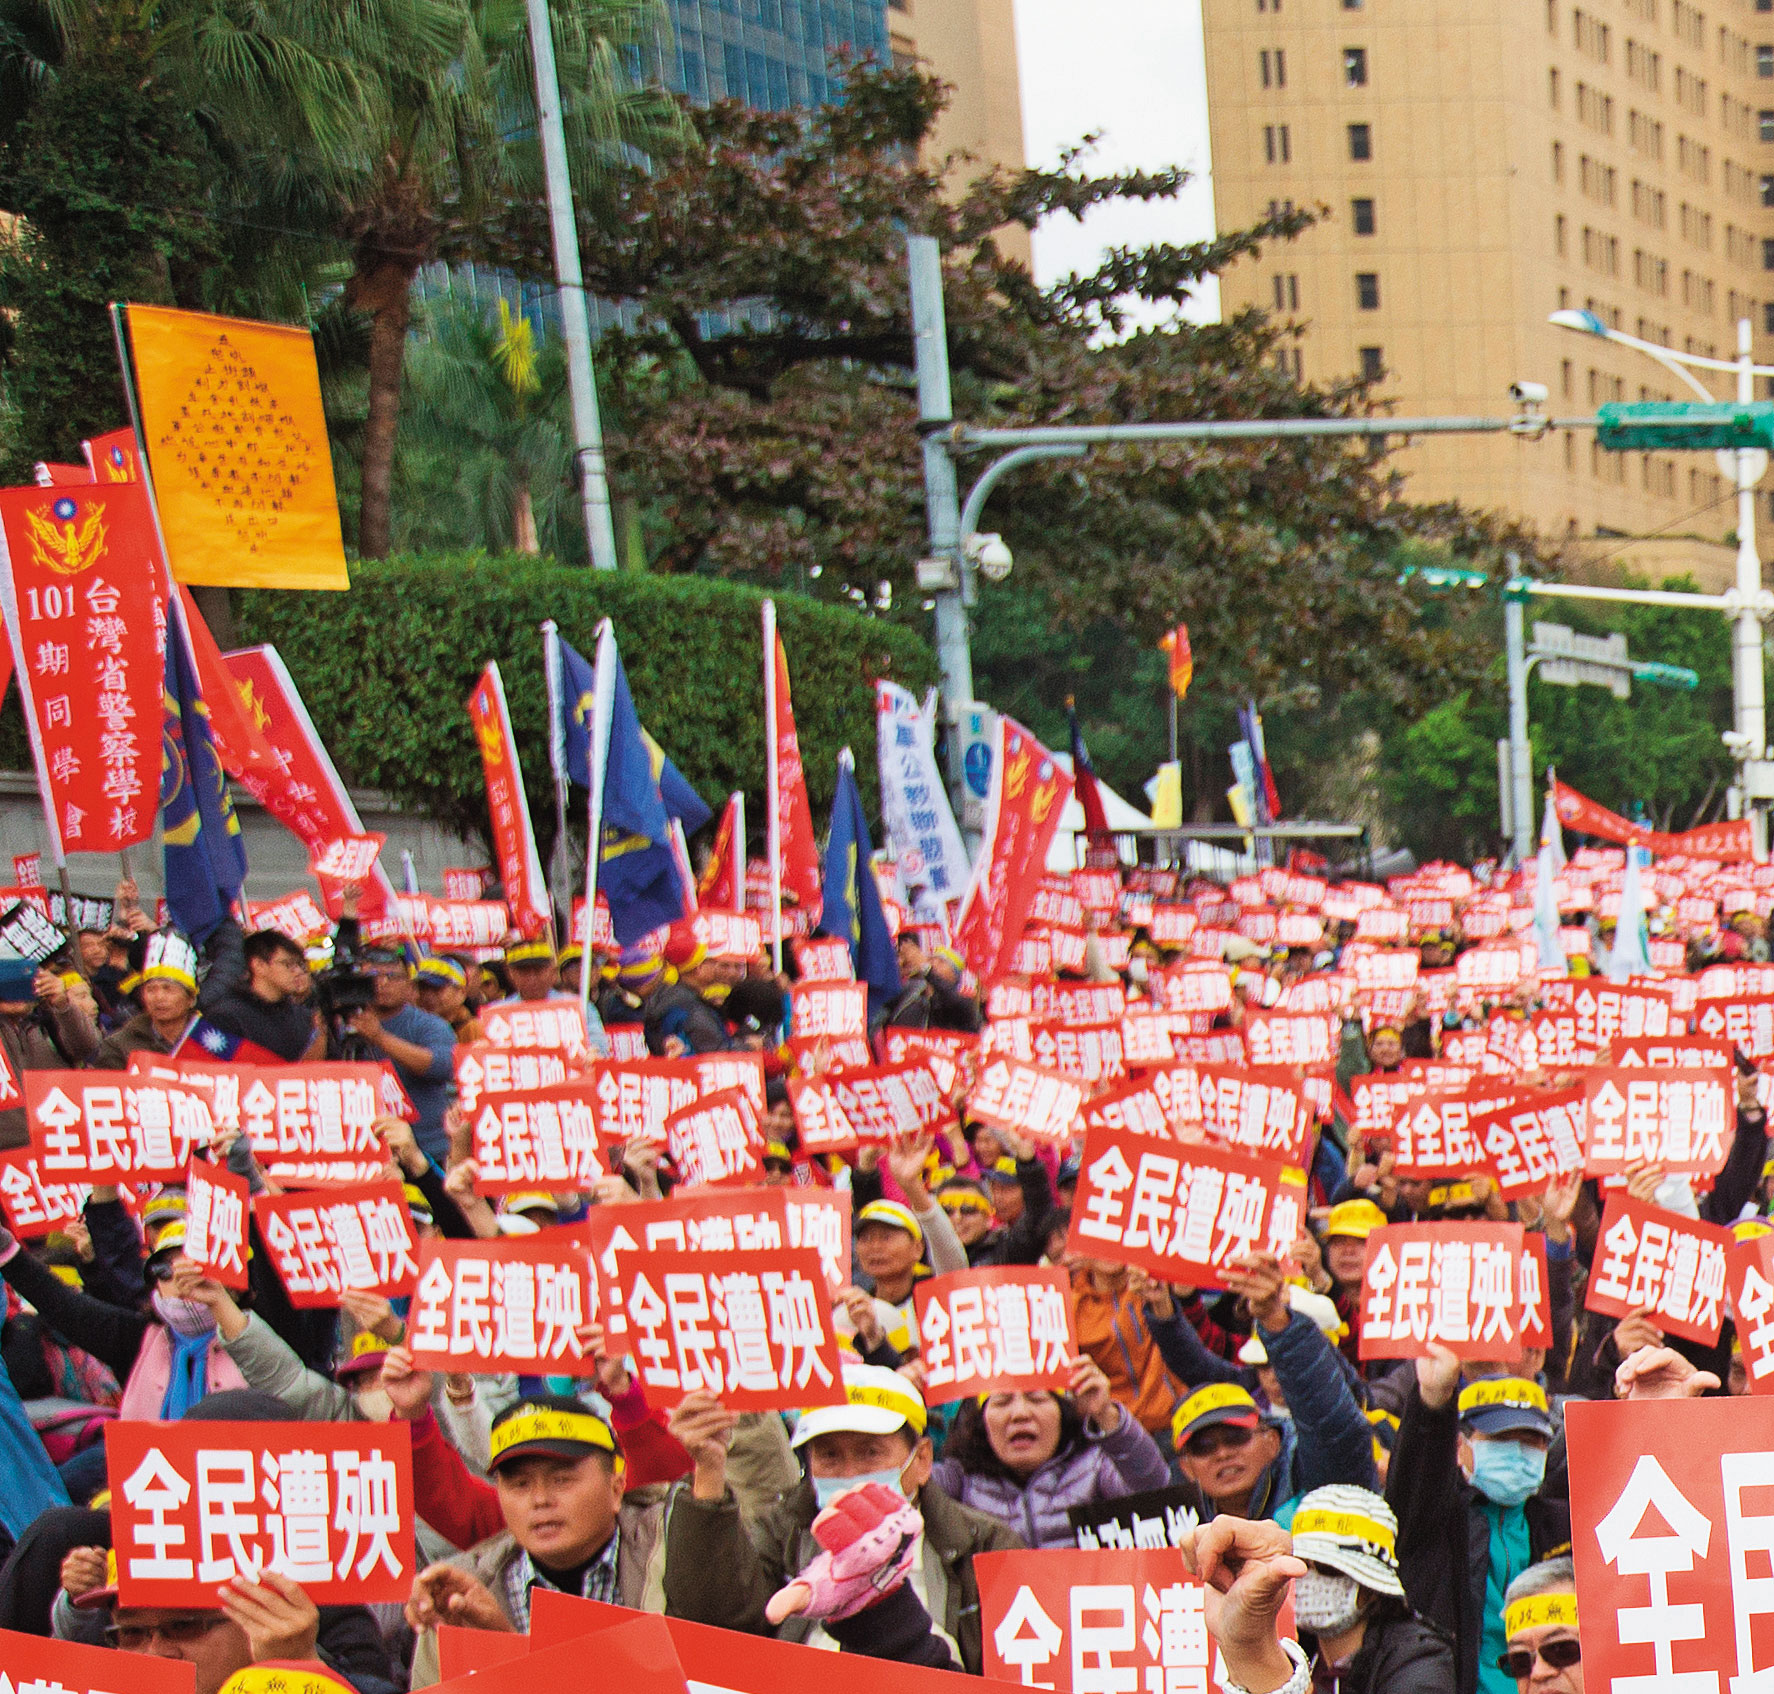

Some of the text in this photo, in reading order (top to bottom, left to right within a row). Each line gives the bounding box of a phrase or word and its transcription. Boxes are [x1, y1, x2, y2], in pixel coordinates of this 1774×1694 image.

[86, 577, 141, 839] 台灣省警察學校
[1575, 988, 1668, 1041] 全民遭殃
[37, 1086, 216, 1172] 全民遭殃
[245, 1080, 381, 1155] 全民遭殃
[478, 1099, 604, 1182] 全民遭殃
[980, 1063, 1083, 1135] 全民遭殃
[1198, 1075, 1298, 1148] 全民遭殃
[1591, 1077, 1726, 1162] 全民遭殃
[267, 1199, 418, 1294] 全民遭殃
[1079, 1142, 1268, 1265] 全民遭殃
[412, 1258, 581, 1358] 全民遭殃
[1361, 1242, 1515, 1345] 全民遭殃
[1596, 1213, 1727, 1325] 全民遭殃
[628, 1268, 832, 1396] 全民遭殃
[919, 1288, 1073, 1386] 全民遭殃
[122, 1448, 402, 1583] 全民遭殃
